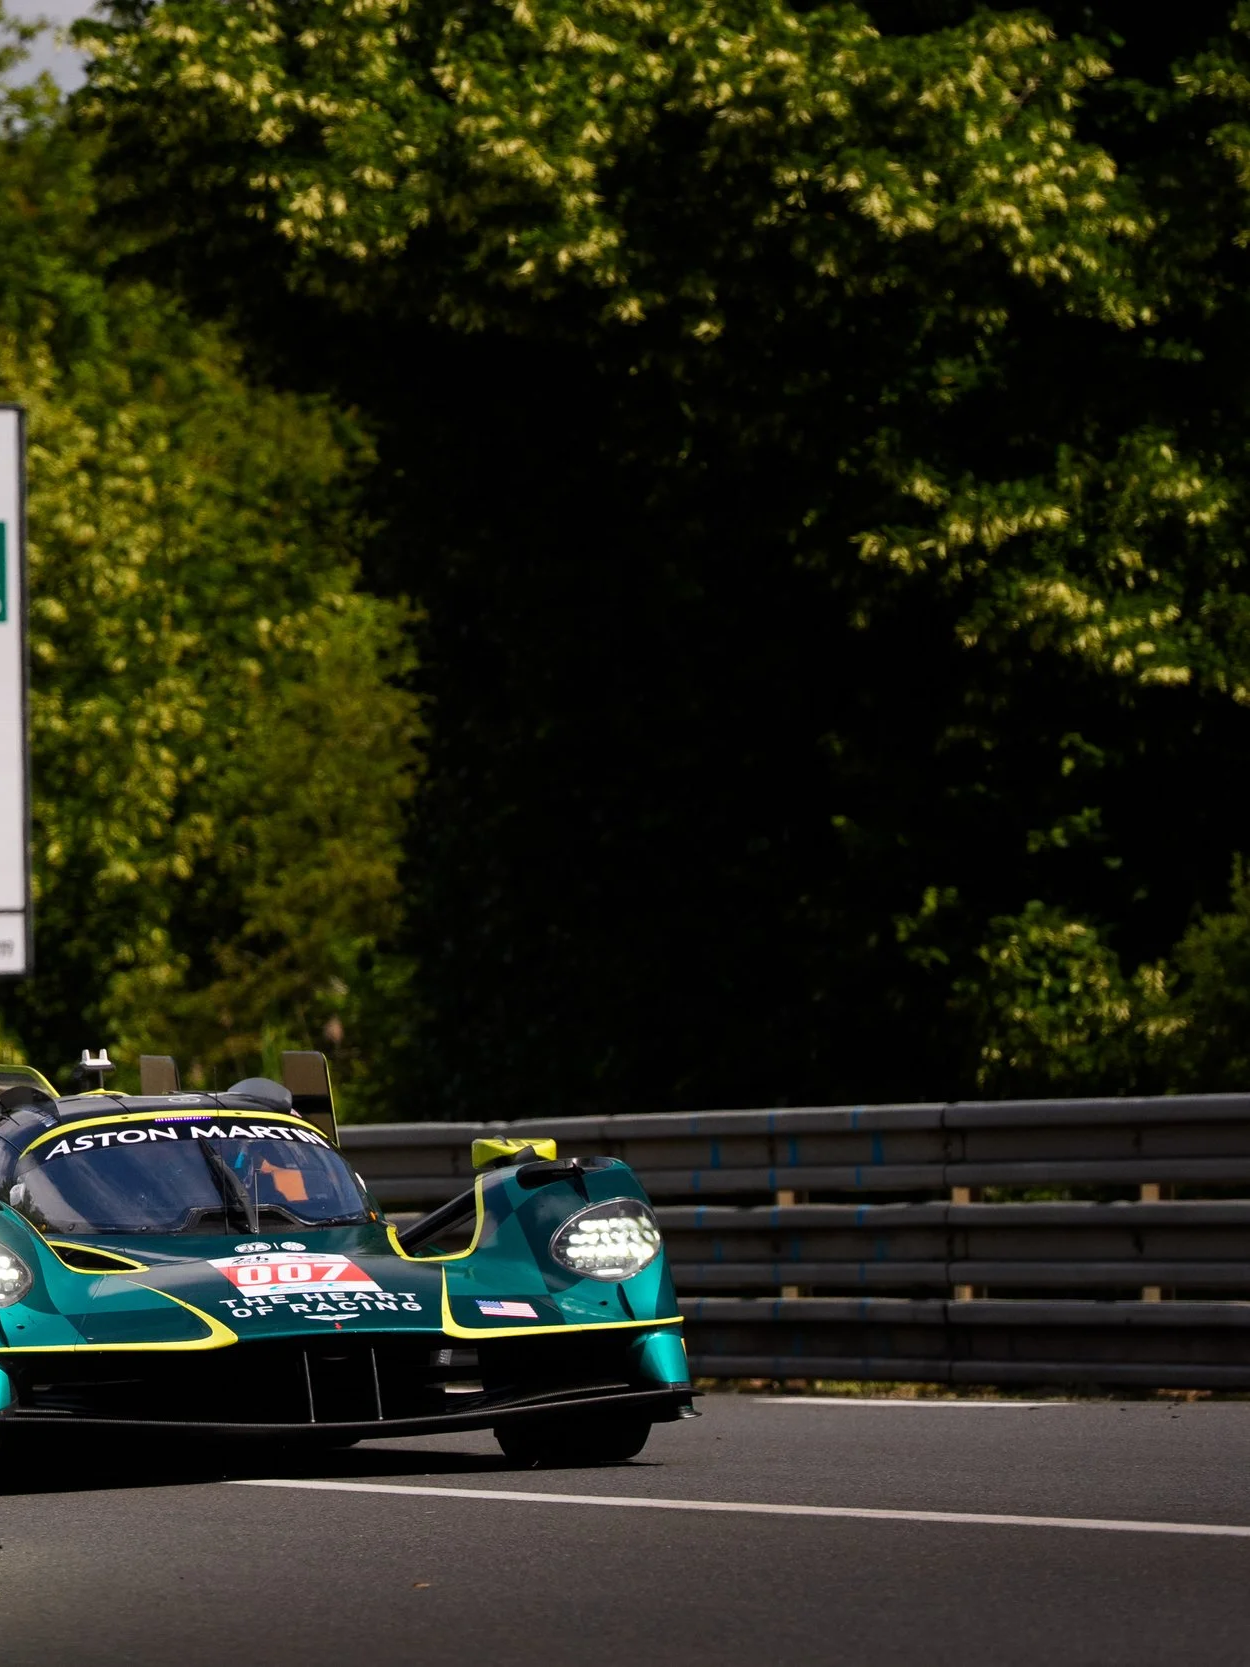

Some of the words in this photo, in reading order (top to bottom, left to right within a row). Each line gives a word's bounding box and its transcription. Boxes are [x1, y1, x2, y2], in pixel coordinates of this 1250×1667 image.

[45, 1126, 179, 1161] ASTON
[190, 1125, 330, 1150] MARTIN
[237, 1263, 349, 1286] 007
[219, 1294, 290, 1309] THE
[301, 1291, 417, 1303] HEART
[231, 1305, 274, 1319] OF
[289, 1301, 423, 1314] RACING
